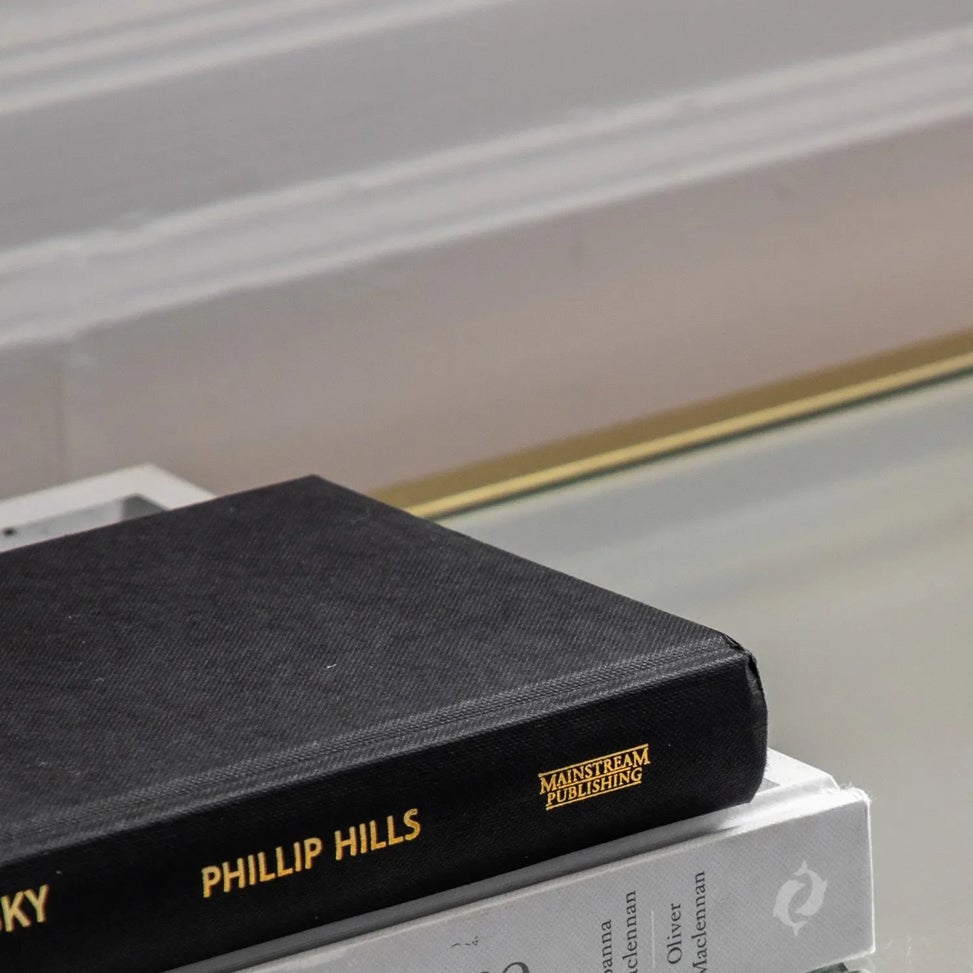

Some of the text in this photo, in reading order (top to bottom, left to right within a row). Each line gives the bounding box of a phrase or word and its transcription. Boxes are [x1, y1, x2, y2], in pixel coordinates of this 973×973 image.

[539, 747, 651, 795] MAINSTREAM
[545, 766, 643, 807] PUBLISHING
[201, 808, 421, 898] PHILLIP HILLS
[0, 884, 49, 932] KY
[666, 902, 683, 965] Oliver
